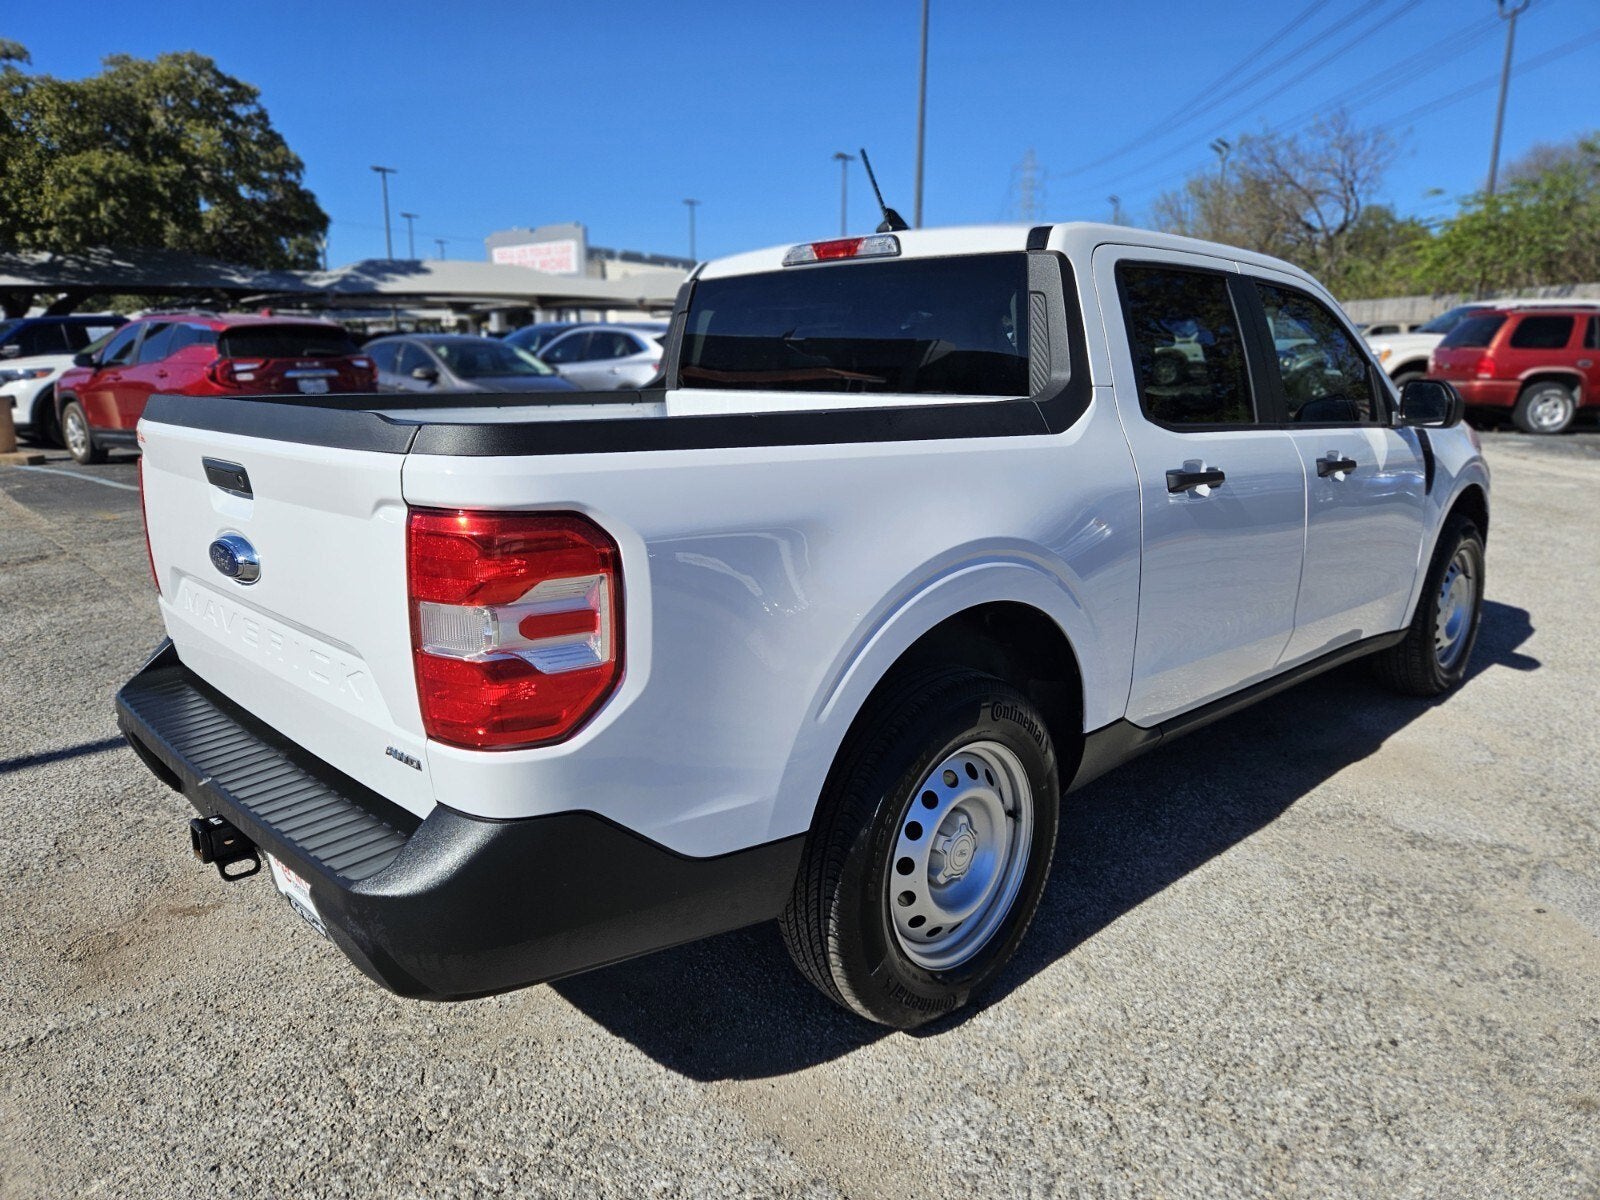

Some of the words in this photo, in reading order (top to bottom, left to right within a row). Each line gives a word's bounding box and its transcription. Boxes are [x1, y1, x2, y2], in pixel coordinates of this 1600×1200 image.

[184, 587, 365, 703] MAVERICK
[991, 701, 1047, 747] Continental
[888, 980, 959, 1013] Continental
